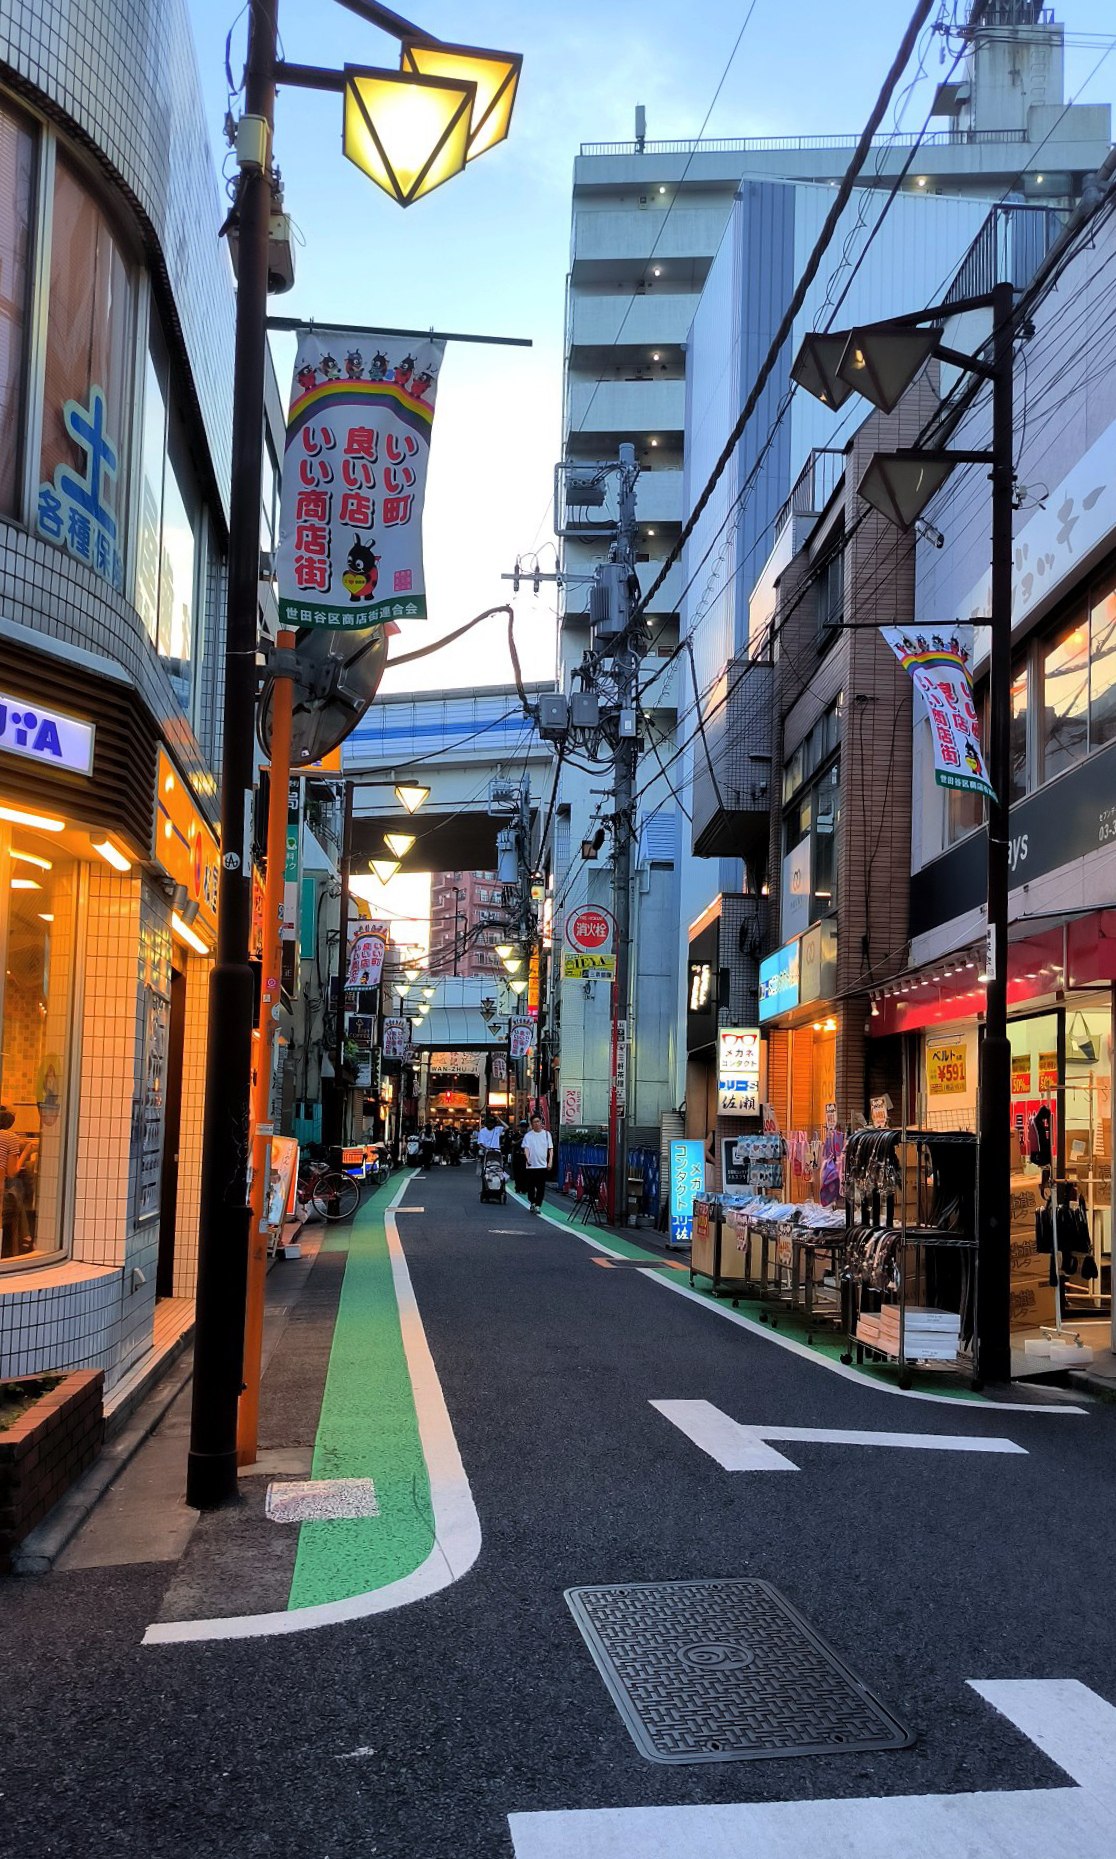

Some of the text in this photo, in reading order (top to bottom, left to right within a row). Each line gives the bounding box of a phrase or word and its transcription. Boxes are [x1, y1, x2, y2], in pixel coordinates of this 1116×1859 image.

[339, 426, 378, 529] 良い店
[382, 433, 418, 527] いい町
[293, 426, 336, 595] いい商店街
[285, 602, 419, 626] 世田谷区商店街連合会
[576, 922, 608, 938] 消火栓
[932, 1050, 956, 1062] ベルト
[937, 1063, 965, 1082] ¥591
[674, 1145, 687, 1211] コンタクト
[690, 1161, 702, 1199] メガ
[675, 1226, 693, 1240] 佐
